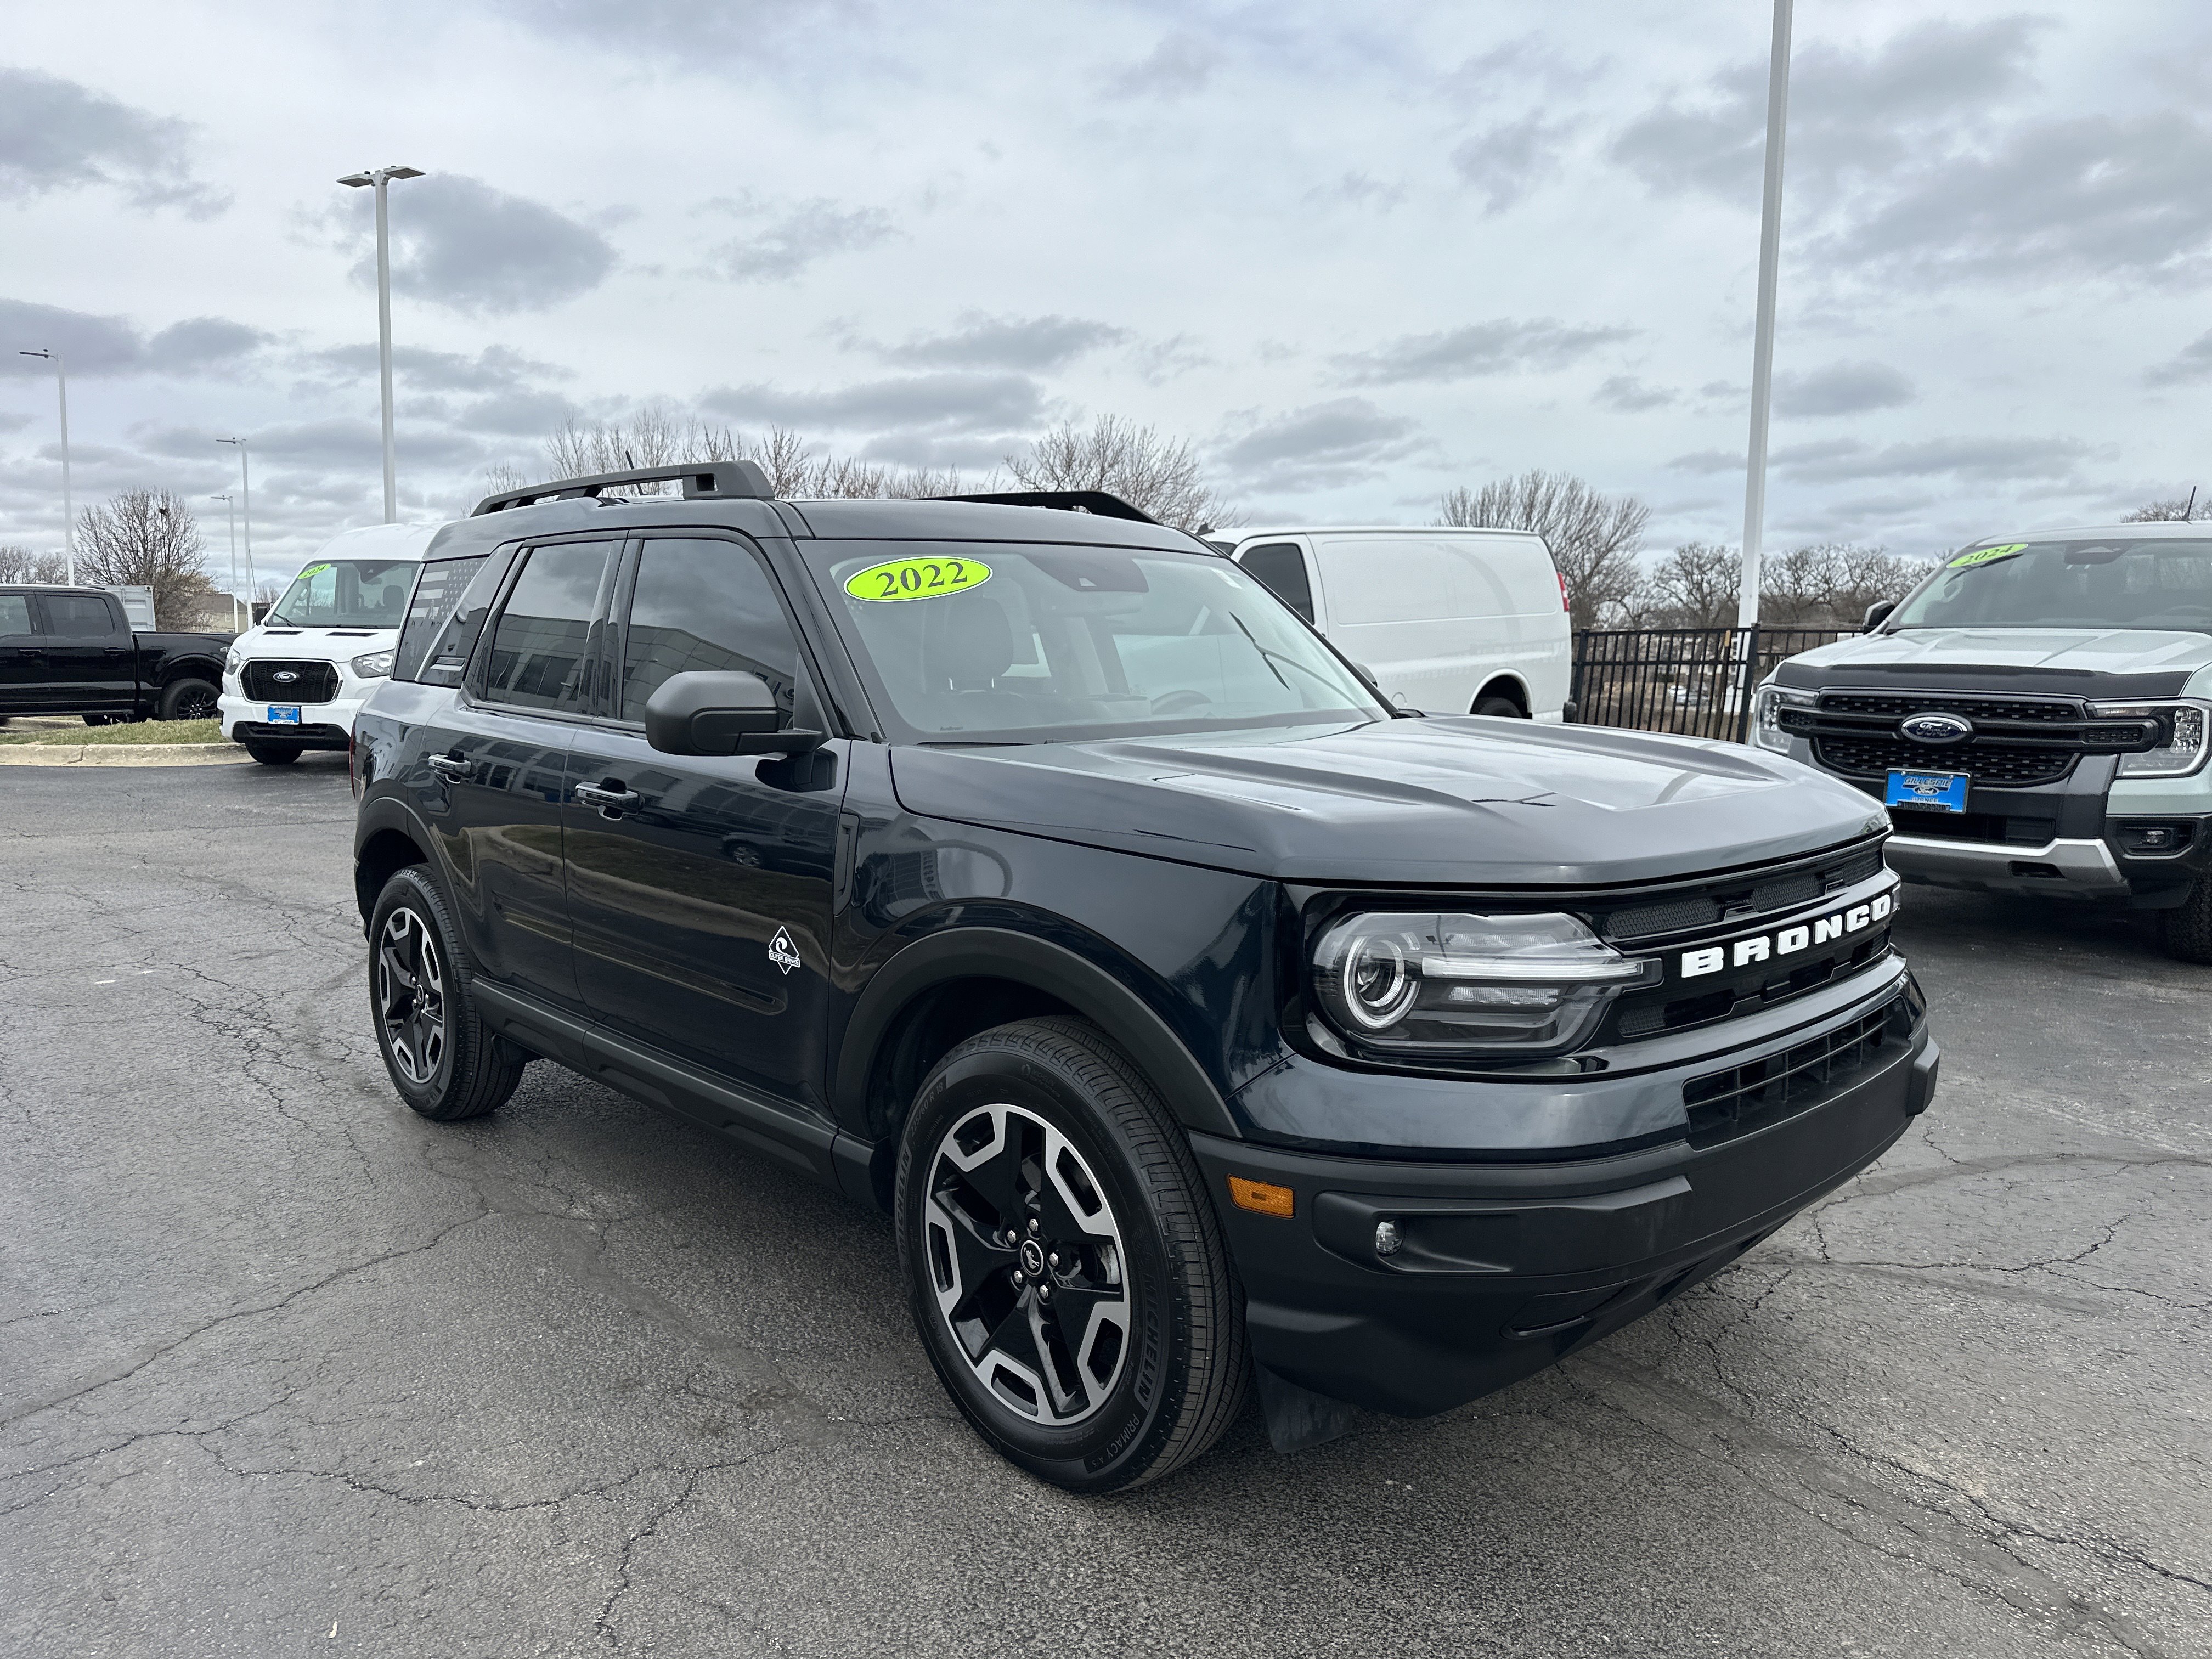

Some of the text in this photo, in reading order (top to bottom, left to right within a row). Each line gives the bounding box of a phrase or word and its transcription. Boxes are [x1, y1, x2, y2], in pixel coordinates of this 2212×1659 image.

[1960, 544, 2015, 565] 2024
[303, 565, 327, 578] 2024
[876, 562, 968, 597] 2022
[1915, 721, 1951, 737] Ford
[1904, 777, 1951, 787] GILLESPIE
[1681, 894, 1891, 978] BRONCO
[770, 952, 799, 966] OUTER BANKS
[929, 1091, 934, 1103] R
[936, 1081, 943, 1095] 18
[897, 1149, 911, 1256] MICHELIN
[1138, 1273, 1159, 1403] MICHELIN
[1106, 1413, 1140, 1459] PRIMACY
